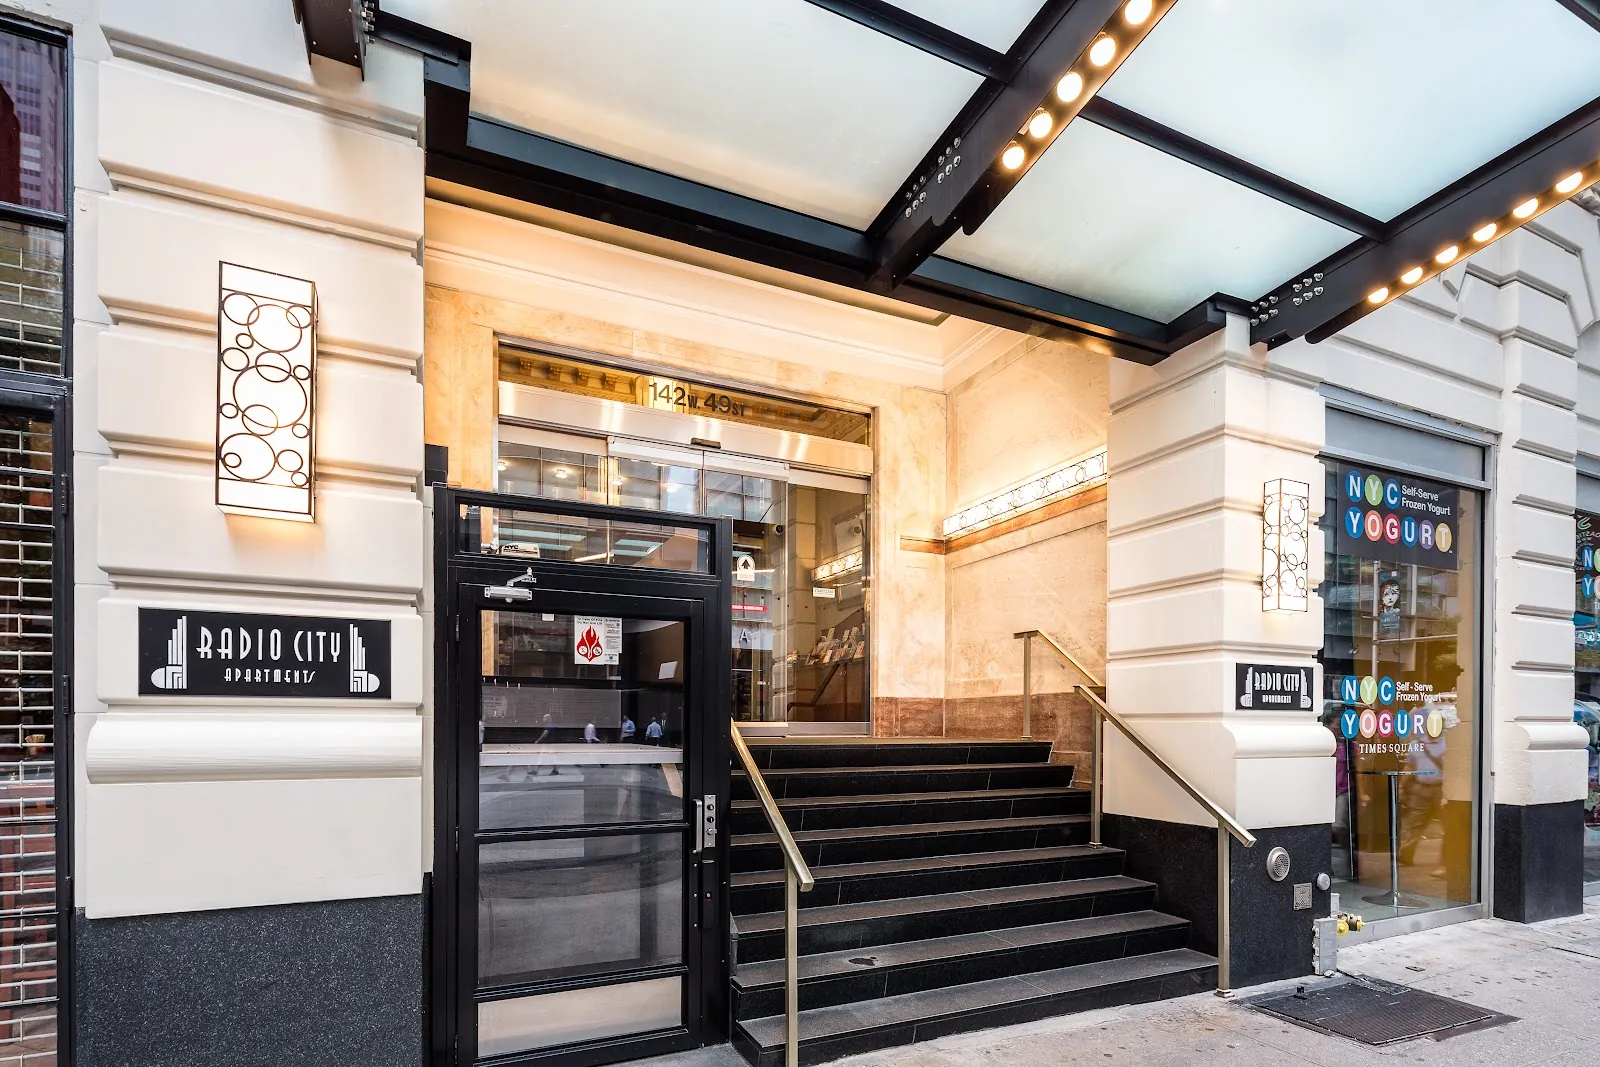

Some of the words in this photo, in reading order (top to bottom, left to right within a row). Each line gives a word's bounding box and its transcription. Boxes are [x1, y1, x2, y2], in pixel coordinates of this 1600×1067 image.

[648, 382, 687, 407] 142
[1349, 474, 1398, 505] NYC
[1401, 485, 1439, 501] Self-Serve
[1401, 497, 1426, 511] Frozen
[1427, 501, 1451, 516] Yogurt
[1349, 511, 1449, 548] YOGURT
[196, 626, 281, 660] RADIO
[293, 630, 341, 663] CITY
[223, 667, 316, 684] APARTMENTS
[1254, 671, 1282, 691] RADIO
[1283, 673, 1300, 692] CITY
[1345, 679, 1392, 702] NYC
[1396, 691, 1420, 702] Frozen
[1420, 692, 1442, 703] Yogurt
[1344, 713, 1442, 735] YOGURT
[1359, 743, 1387, 754] TIMES
[1388, 742, 1425, 754] SQUARE
